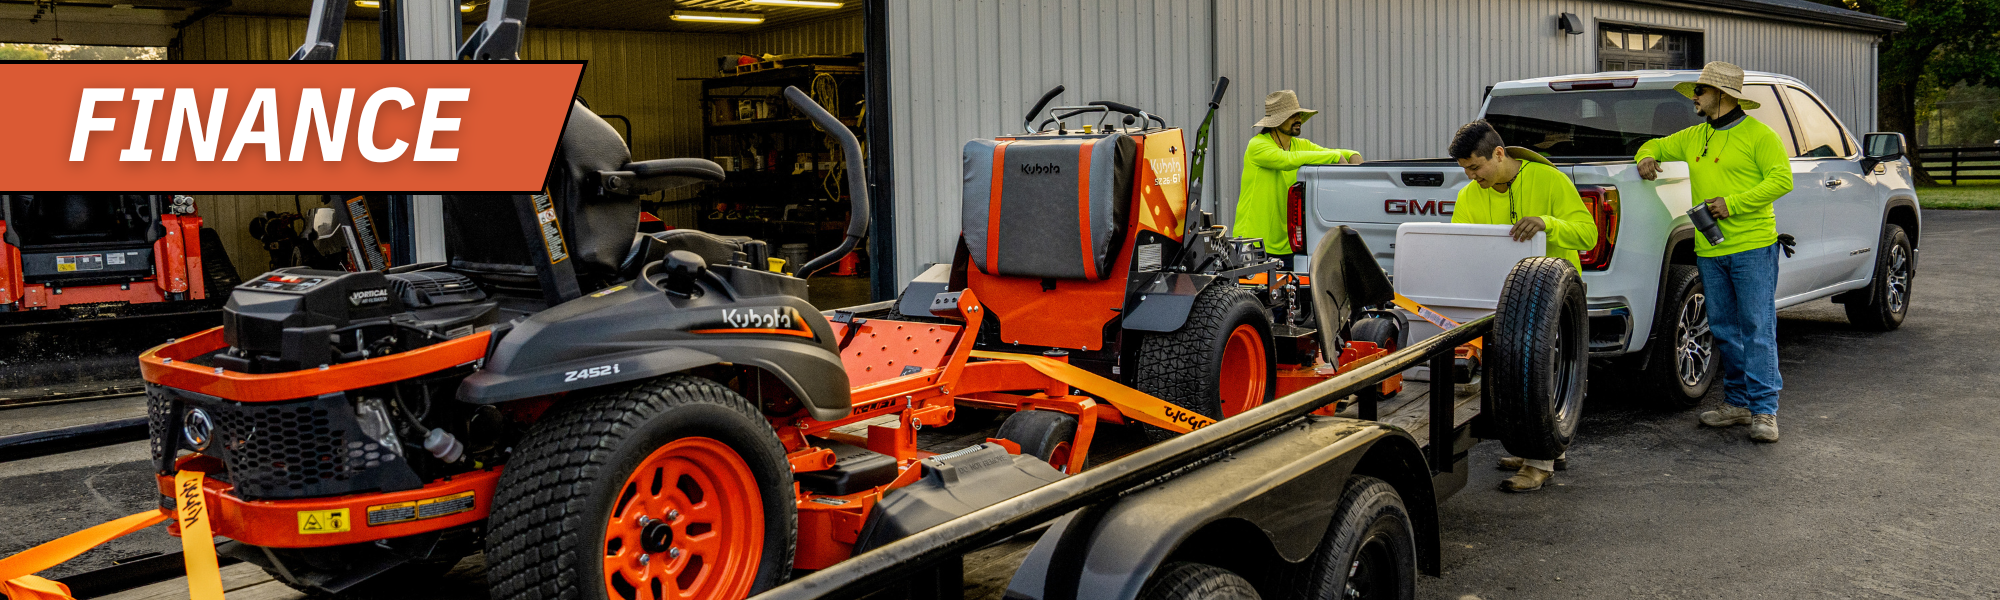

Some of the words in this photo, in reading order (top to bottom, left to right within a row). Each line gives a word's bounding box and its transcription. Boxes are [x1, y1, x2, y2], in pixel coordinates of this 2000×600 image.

[1021, 163, 1060, 175] Kubota
[1150, 158, 1182, 174] Kubota
[1384, 199, 1456, 216] GMC
[353, 289, 388, 299] VORTICAL
[722, 308, 791, 328] Kubota
[564, 363, 621, 383] Z452i
[855, 399, 894, 415] K-LIFT
[1164, 405, 1212, 430] ubota
[969, 462, 983, 471] NOT
[982, 455, 1008, 467] REMOVE
[180, 478, 203, 529] Kubota
